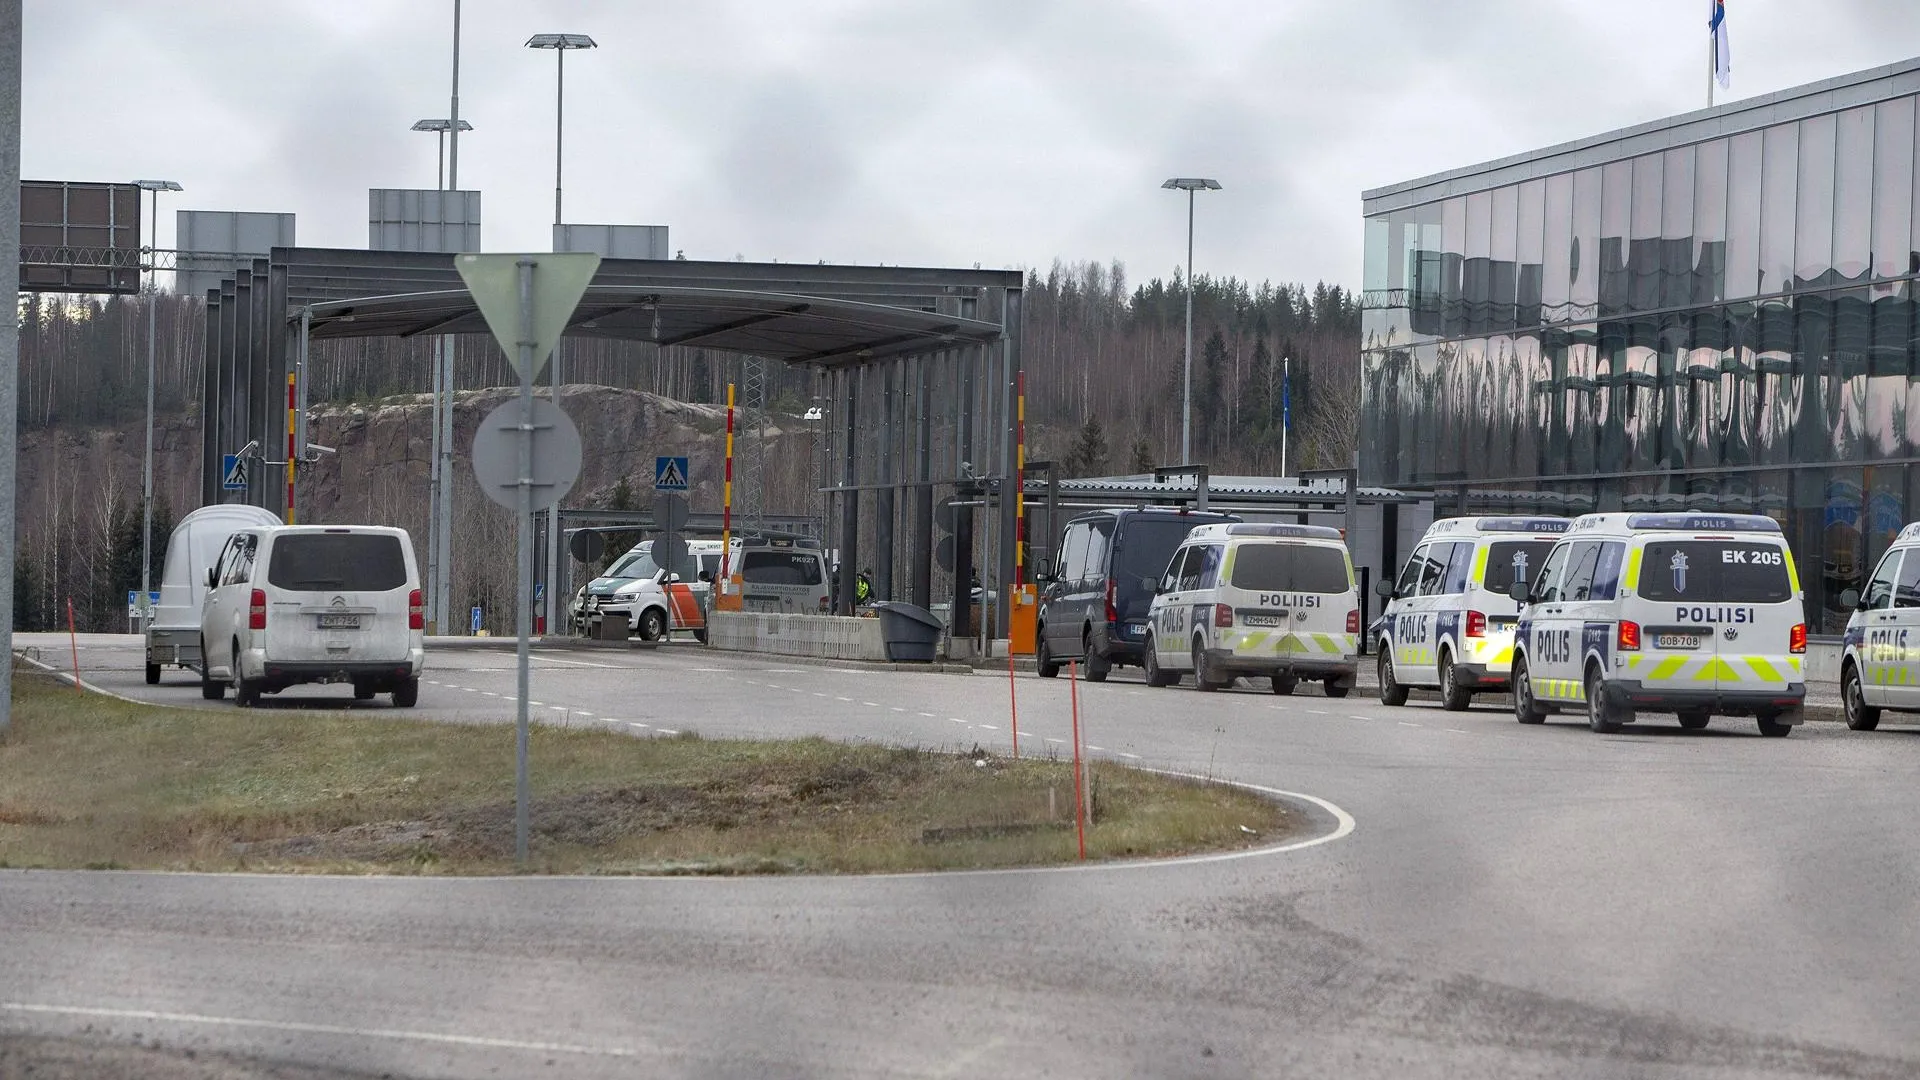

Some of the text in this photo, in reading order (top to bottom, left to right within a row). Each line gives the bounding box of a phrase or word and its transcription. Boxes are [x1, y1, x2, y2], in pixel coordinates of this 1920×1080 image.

[1534, 523, 1563, 531] POLIS
[1693, 520, 1727, 528] POLIS
[1722, 550, 1782, 565] EK 205
[1260, 593, 1321, 608] POLIISI
[1161, 606, 1185, 633] POLIS
[1676, 607, 1754, 623] POLIISI
[1400, 614, 1428, 644] POLIS
[1537, 630, 1570, 663] POLIS
[1660, 636, 1699, 646] GOB-708
[1870, 629, 1908, 662] POLIS
